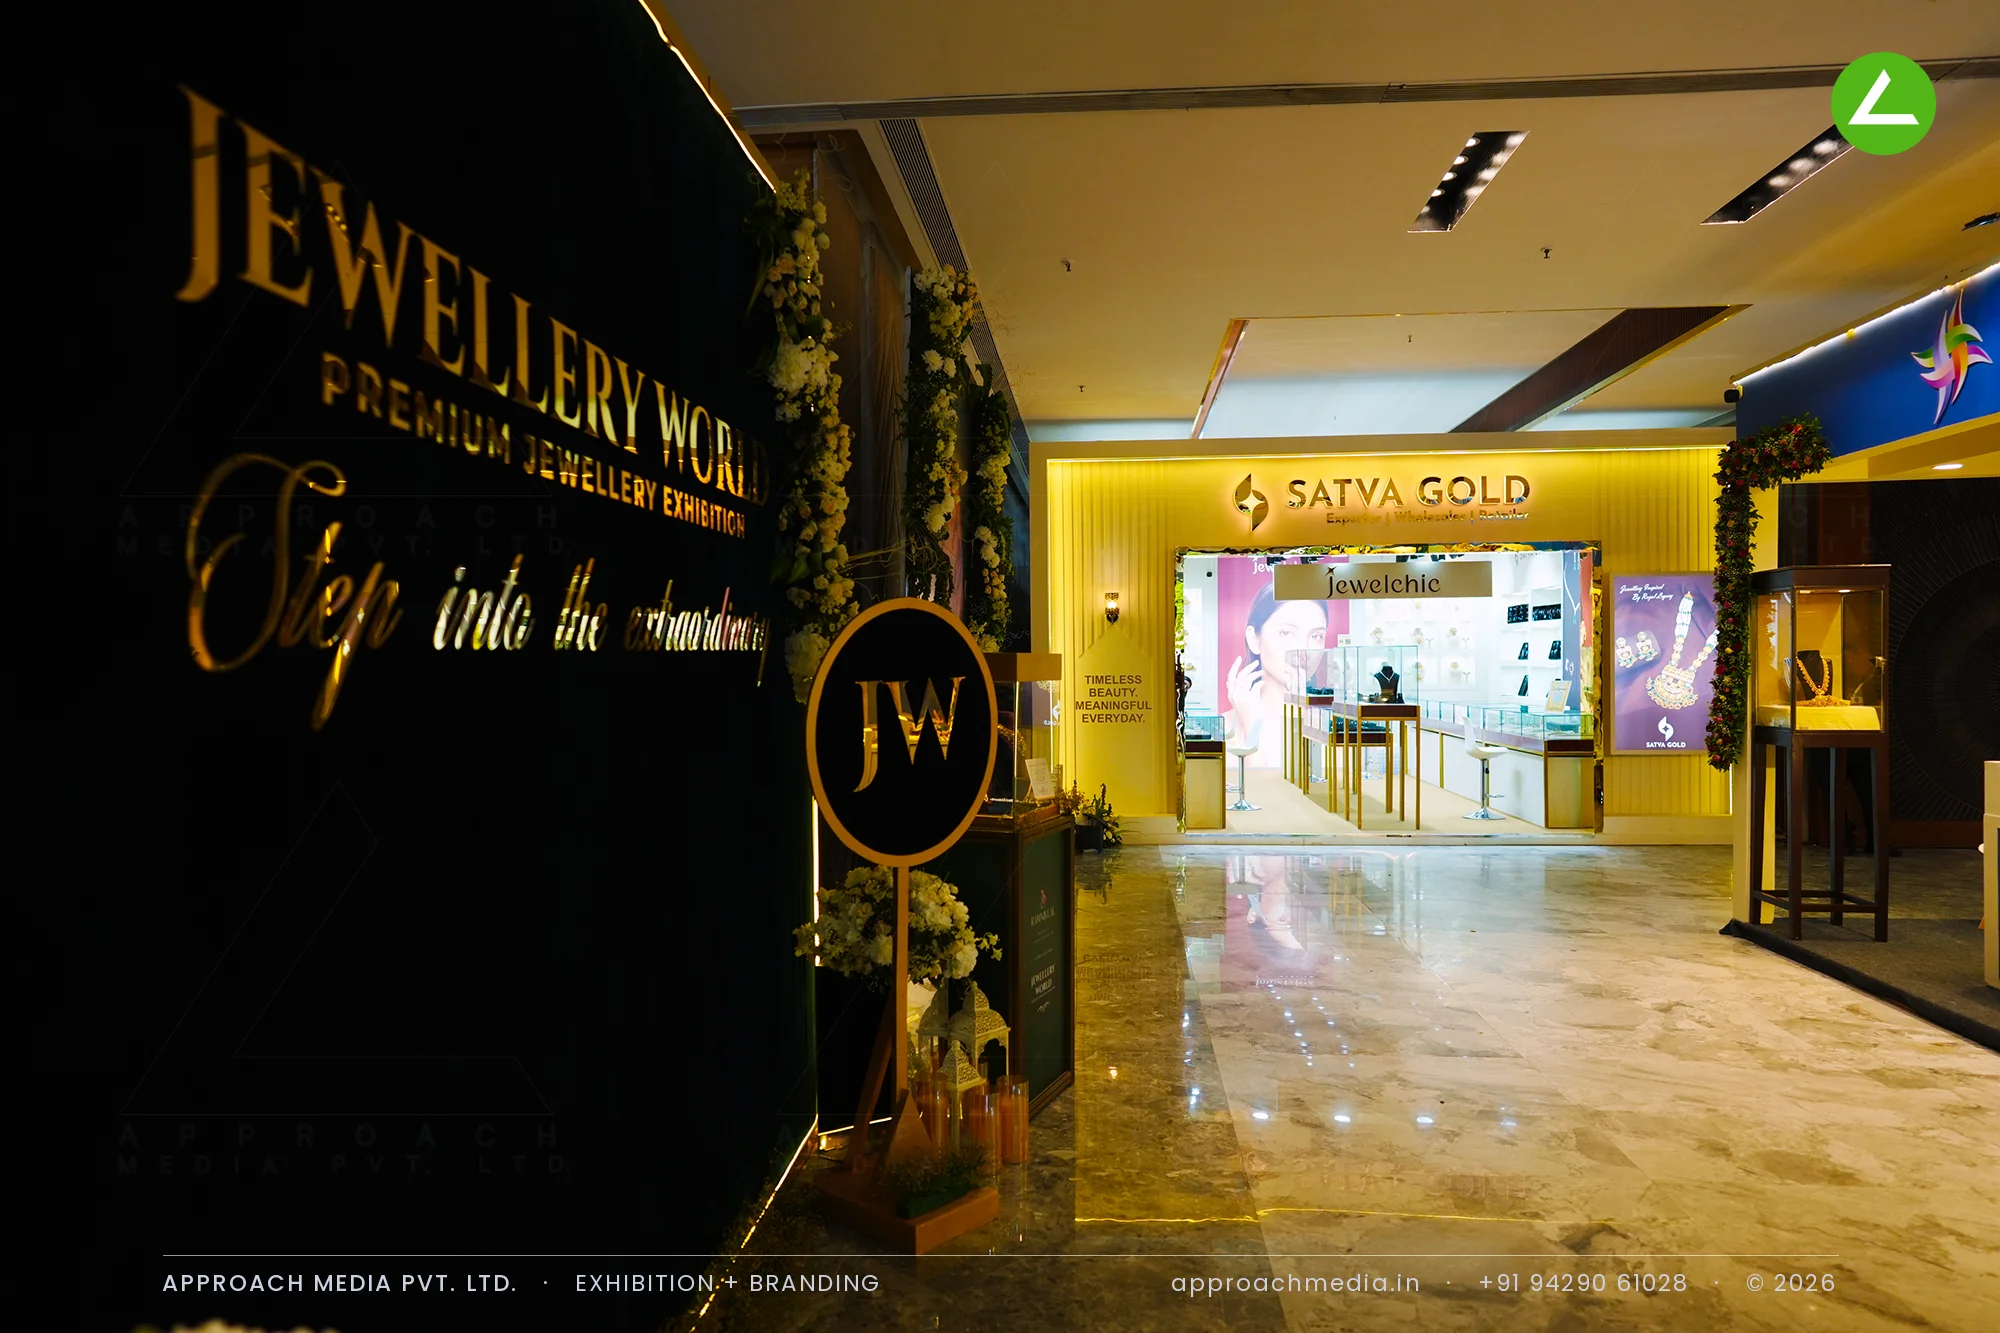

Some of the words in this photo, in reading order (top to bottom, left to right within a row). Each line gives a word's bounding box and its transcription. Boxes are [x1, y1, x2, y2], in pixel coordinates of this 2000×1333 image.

[173, 81, 648, 456] JEWELLERY
[651, 376, 770, 508] WORLD
[320, 350, 512, 464] PREMIUM
[521, 432, 658, 513] JEWELLERY
[662, 483, 747, 540] EXHIBITION
[1287, 477, 1404, 508] SATVA
[1416, 475, 1530, 505] GOLD
[1394, 510, 1466, 525] Wholesaler
[1479, 508, 1530, 522] Retailer
[184, 452, 404, 732] Step
[432, 564, 536, 653] into
[553, 556, 611, 652] the
[623, 579, 773, 688] extraordinary
[1326, 566, 1441, 599] jewelchic
[1084, 674, 1143, 685] TIMELESS
[1089, 687, 1139, 698] BEAUTY.
[1075, 700, 1153, 711] MEANINGFUL
[1081, 713, 1146, 724] EVERYDAY.
[852, 676, 967, 793] JW
